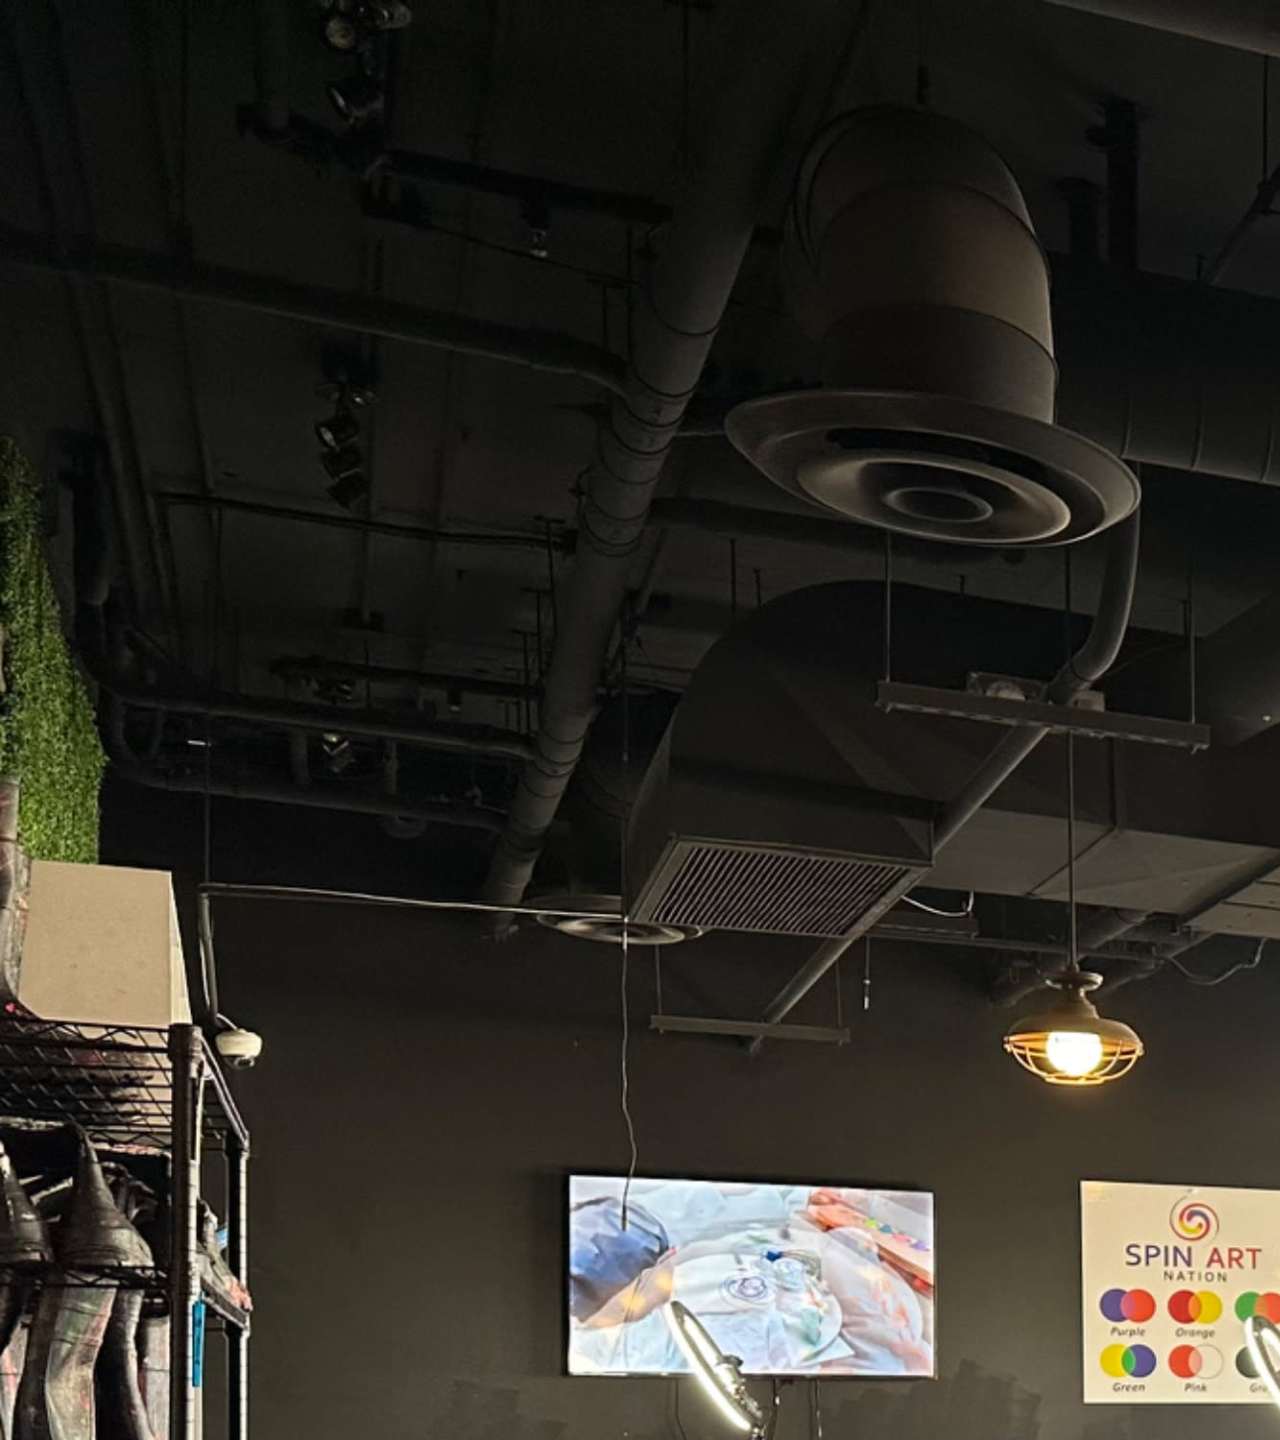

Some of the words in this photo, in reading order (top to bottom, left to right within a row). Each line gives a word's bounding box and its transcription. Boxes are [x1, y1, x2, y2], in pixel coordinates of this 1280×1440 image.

[1125, 1243, 1192, 1268] SPIN
[1206, 1247, 1262, 1270] ART
[1163, 1270, 1228, 1283] NATION
[1110, 1326, 1146, 1338] Purple
[1175, 1327, 1216, 1340] Orange
[1112, 1382, 1146, 1393] Green
[1184, 1382, 1207, 1392] Pink
